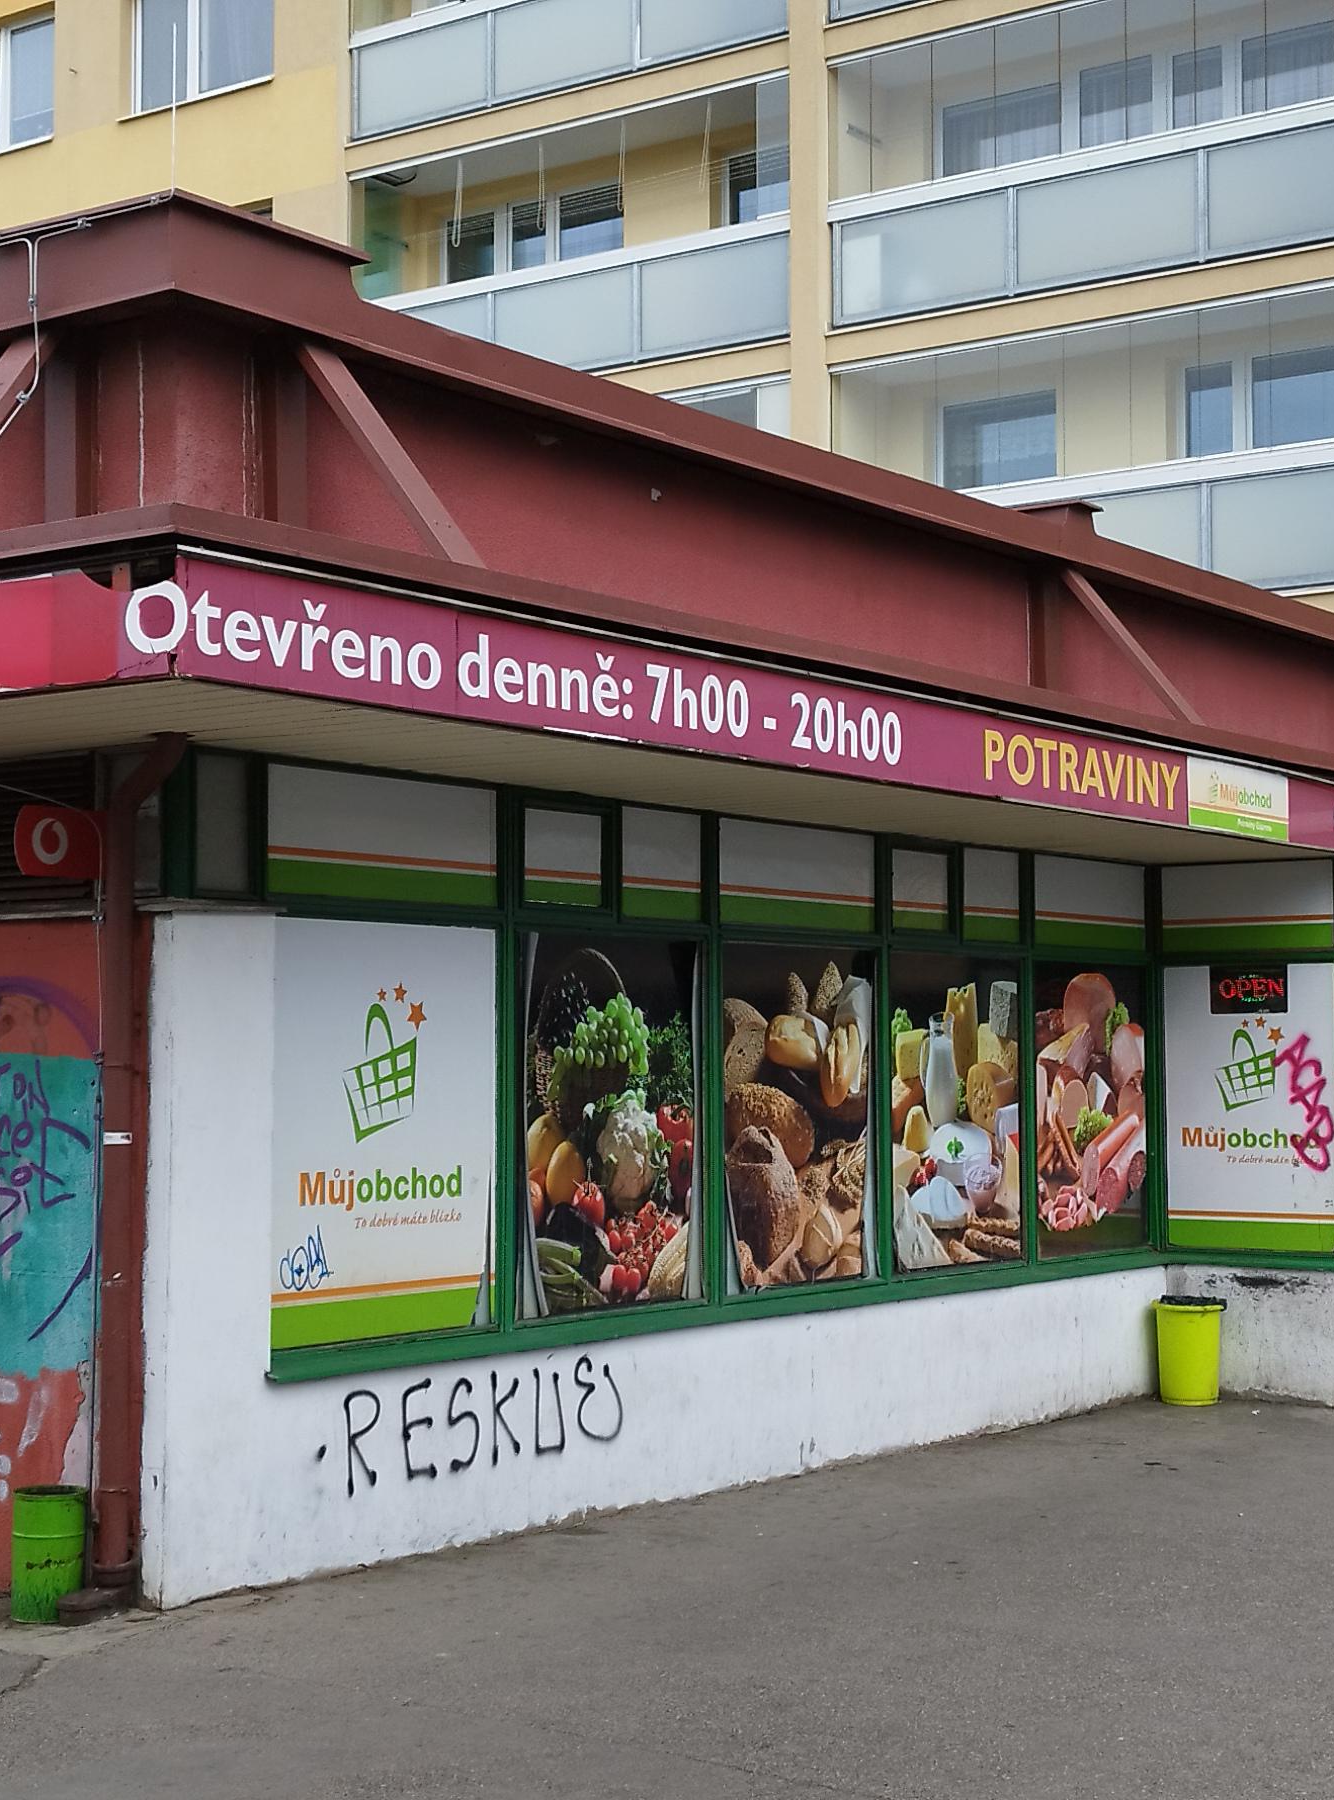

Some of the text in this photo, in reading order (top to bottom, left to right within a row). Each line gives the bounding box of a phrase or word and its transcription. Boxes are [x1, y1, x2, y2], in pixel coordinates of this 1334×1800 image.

[125, 580, 903, 766] Otevřeno denně: 7h00 - 20h00
[984, 729, 1181, 811] POTRAVINY
[1218, 977, 1285, 999] OPEN
[1181, 1125, 1321, 1151] Můjobch
[298, 1164, 463, 1211] Můjobchod
[355, 1208, 462, 1229] To dobré máte blízko
